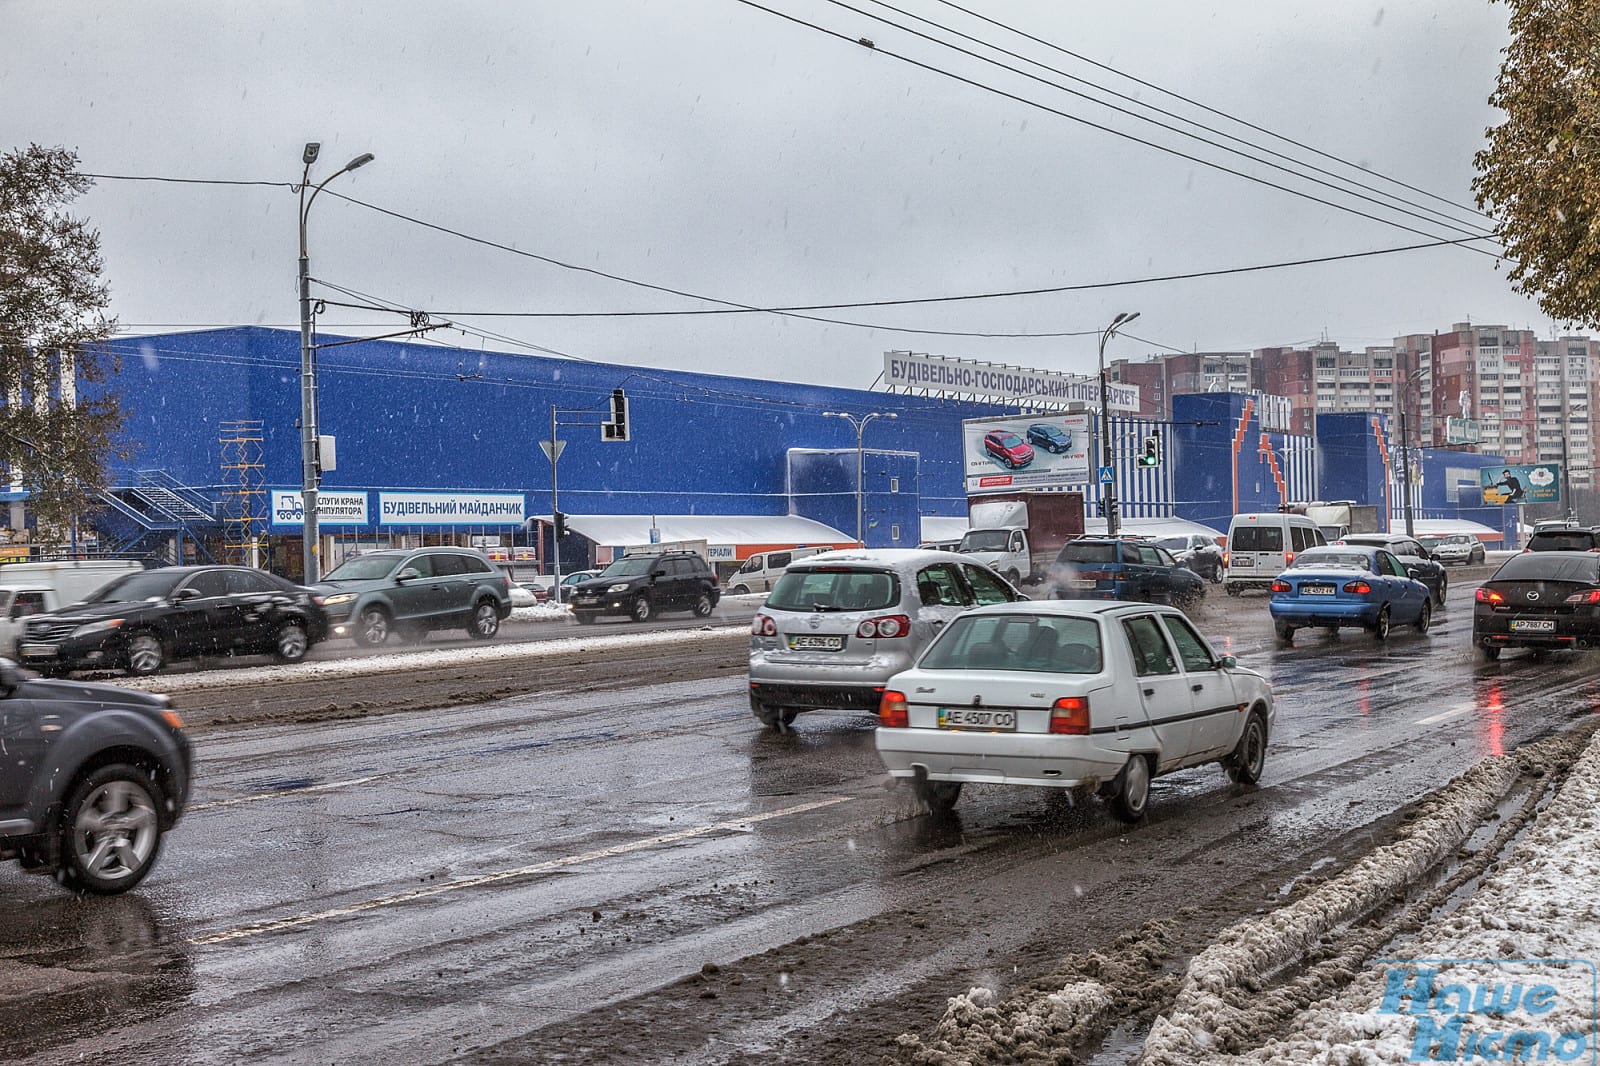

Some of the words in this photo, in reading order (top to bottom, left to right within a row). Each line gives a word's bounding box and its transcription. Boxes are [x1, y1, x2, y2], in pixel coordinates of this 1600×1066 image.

[891, 359, 1070, 399] БУДІВЕЛЬНО-ГОСПОДАРСЬКИЙ
[1072, 382, 1136, 406] ГІПЕРАРКЕТ
[317, 497, 340, 506] СЛУГИ
[340, 497, 364, 506] КРАНА
[314, 506, 362, 515] АНІПУЛЯТОРА
[383, 499, 458, 516] БУДІВЕЛЬНИЙ
[459, 499, 522, 517] МАЙДАНЧИК
[707, 548, 733, 557] ТЕРІАЛИ
[946, 711, 963, 724] AE
